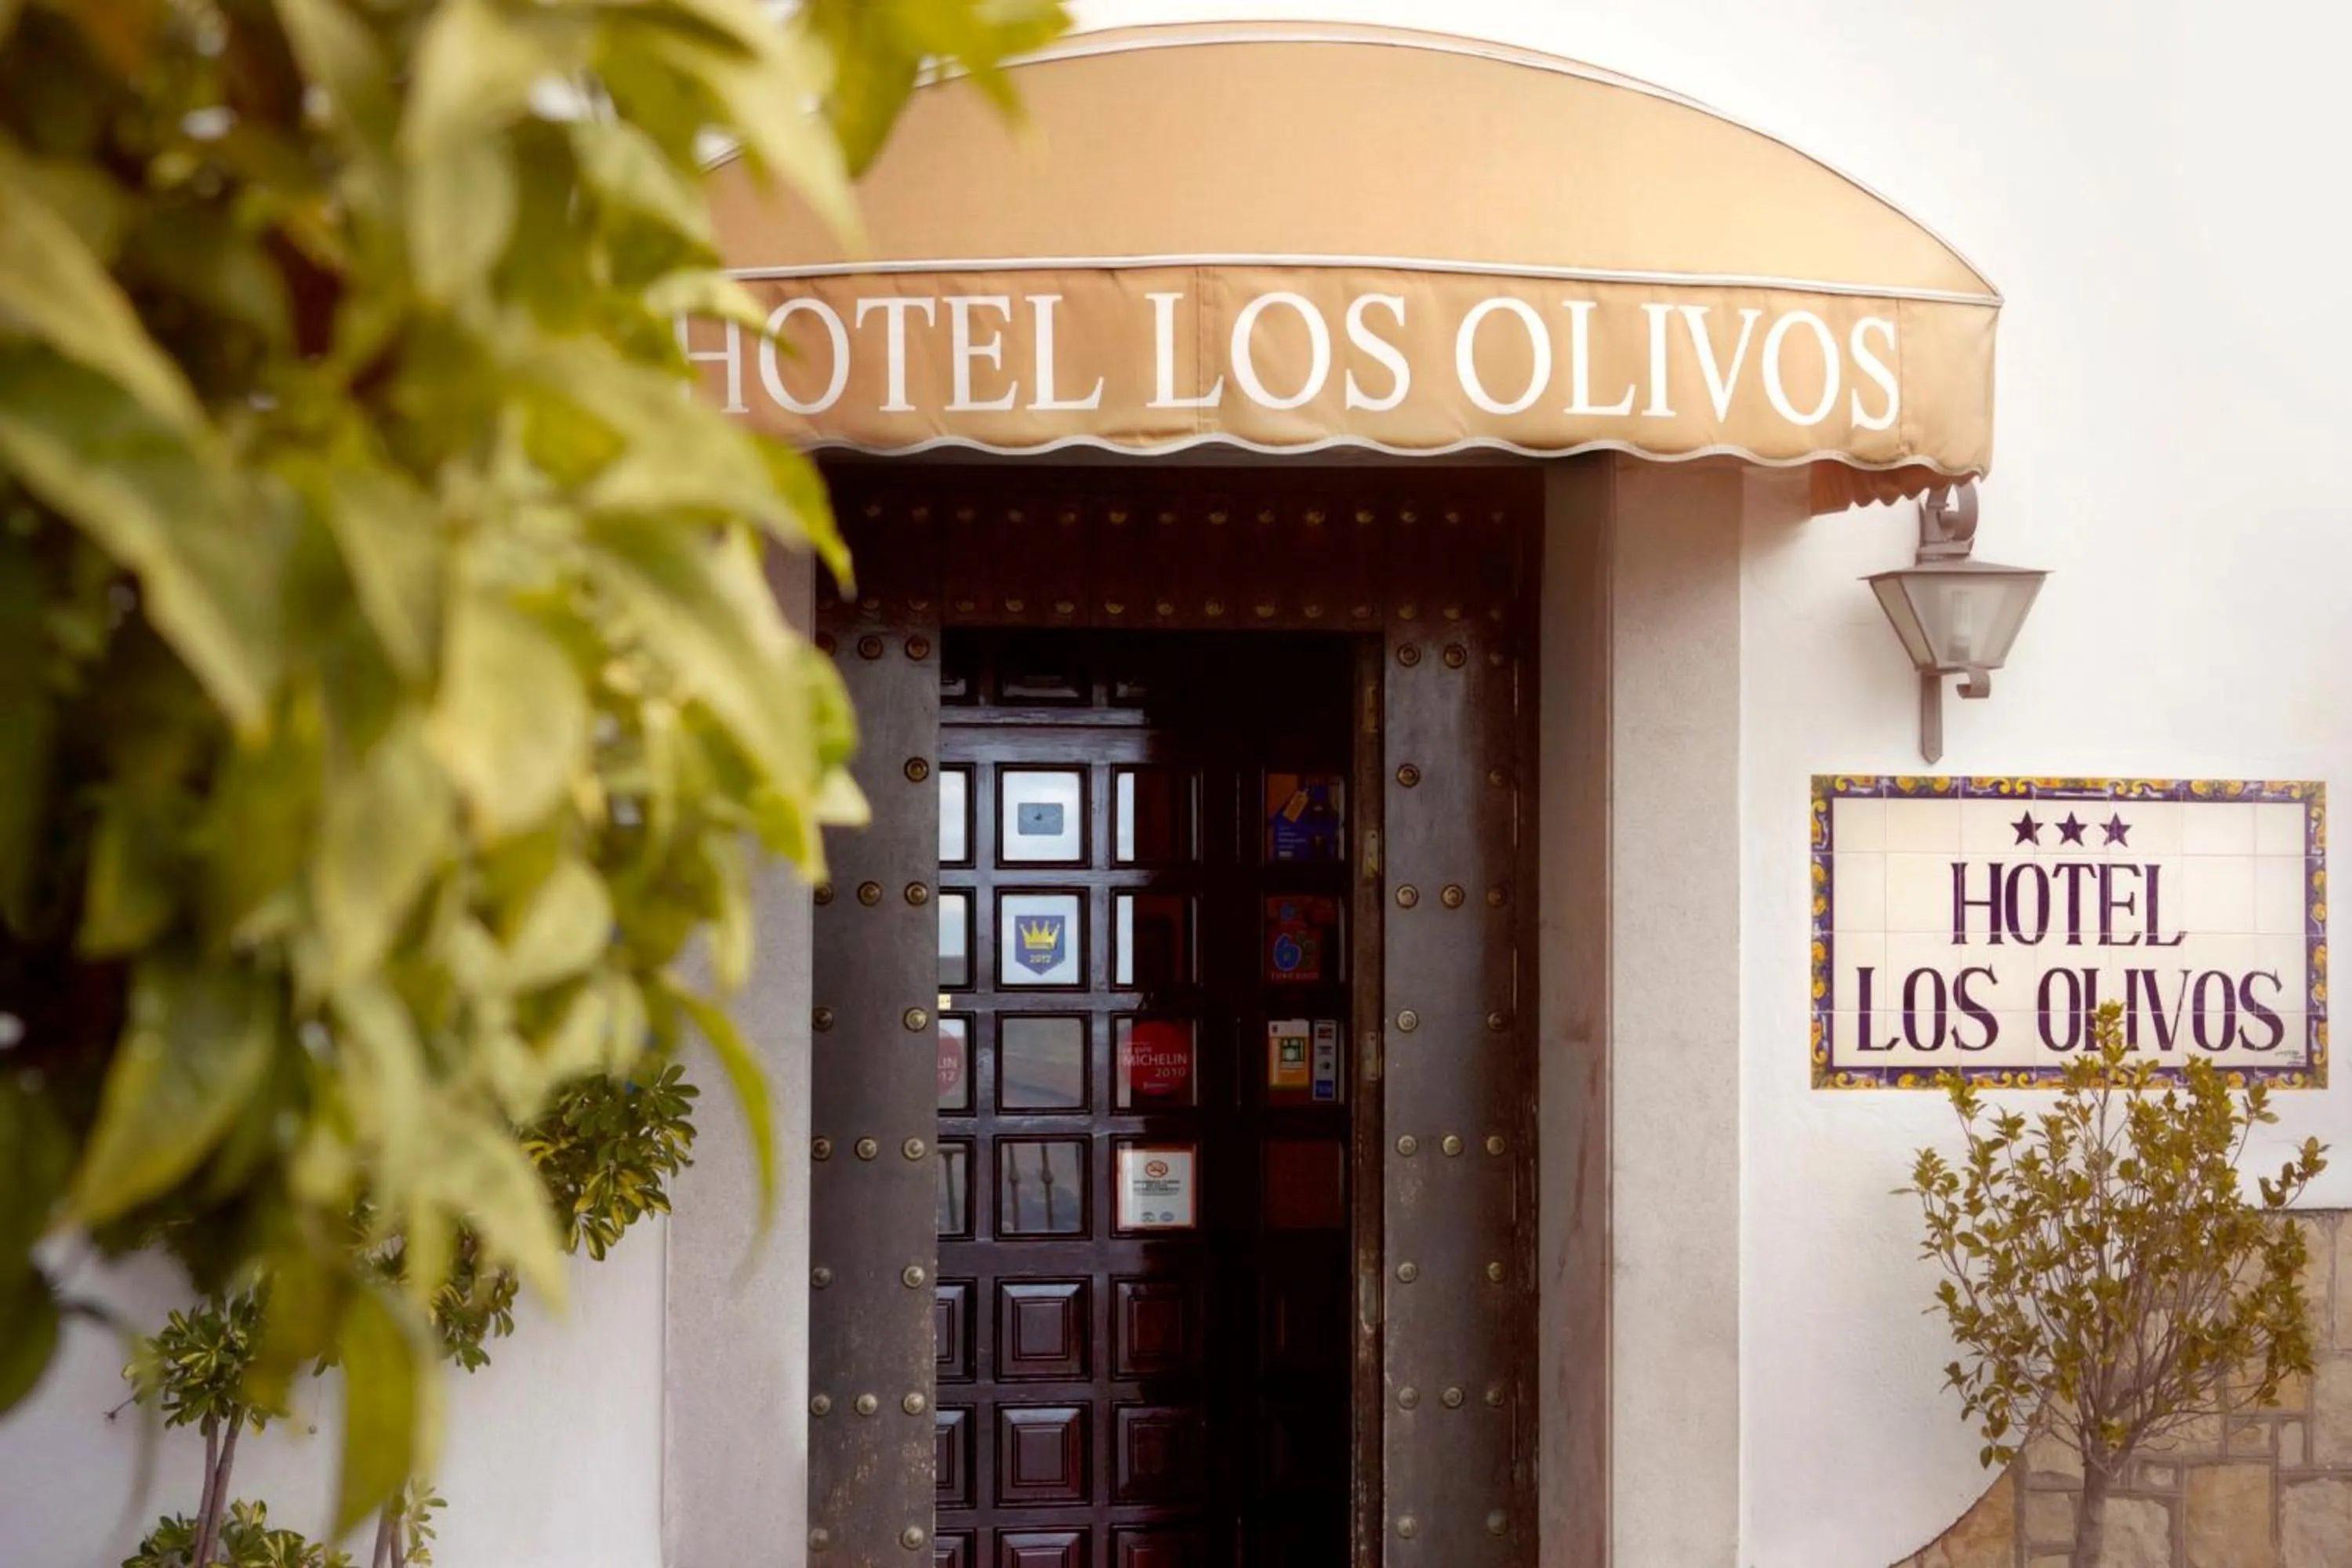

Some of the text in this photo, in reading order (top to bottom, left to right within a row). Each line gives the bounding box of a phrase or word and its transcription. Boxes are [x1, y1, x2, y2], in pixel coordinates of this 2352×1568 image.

[675, 291, 1901, 431] HOTEL LOS OLIVOS
[1949, 862, 2188, 947] HOTEL
[1856, 964, 2285, 1052] LOS OLIVOS
[1123, 1052, 1187, 1067] MICHELIN
